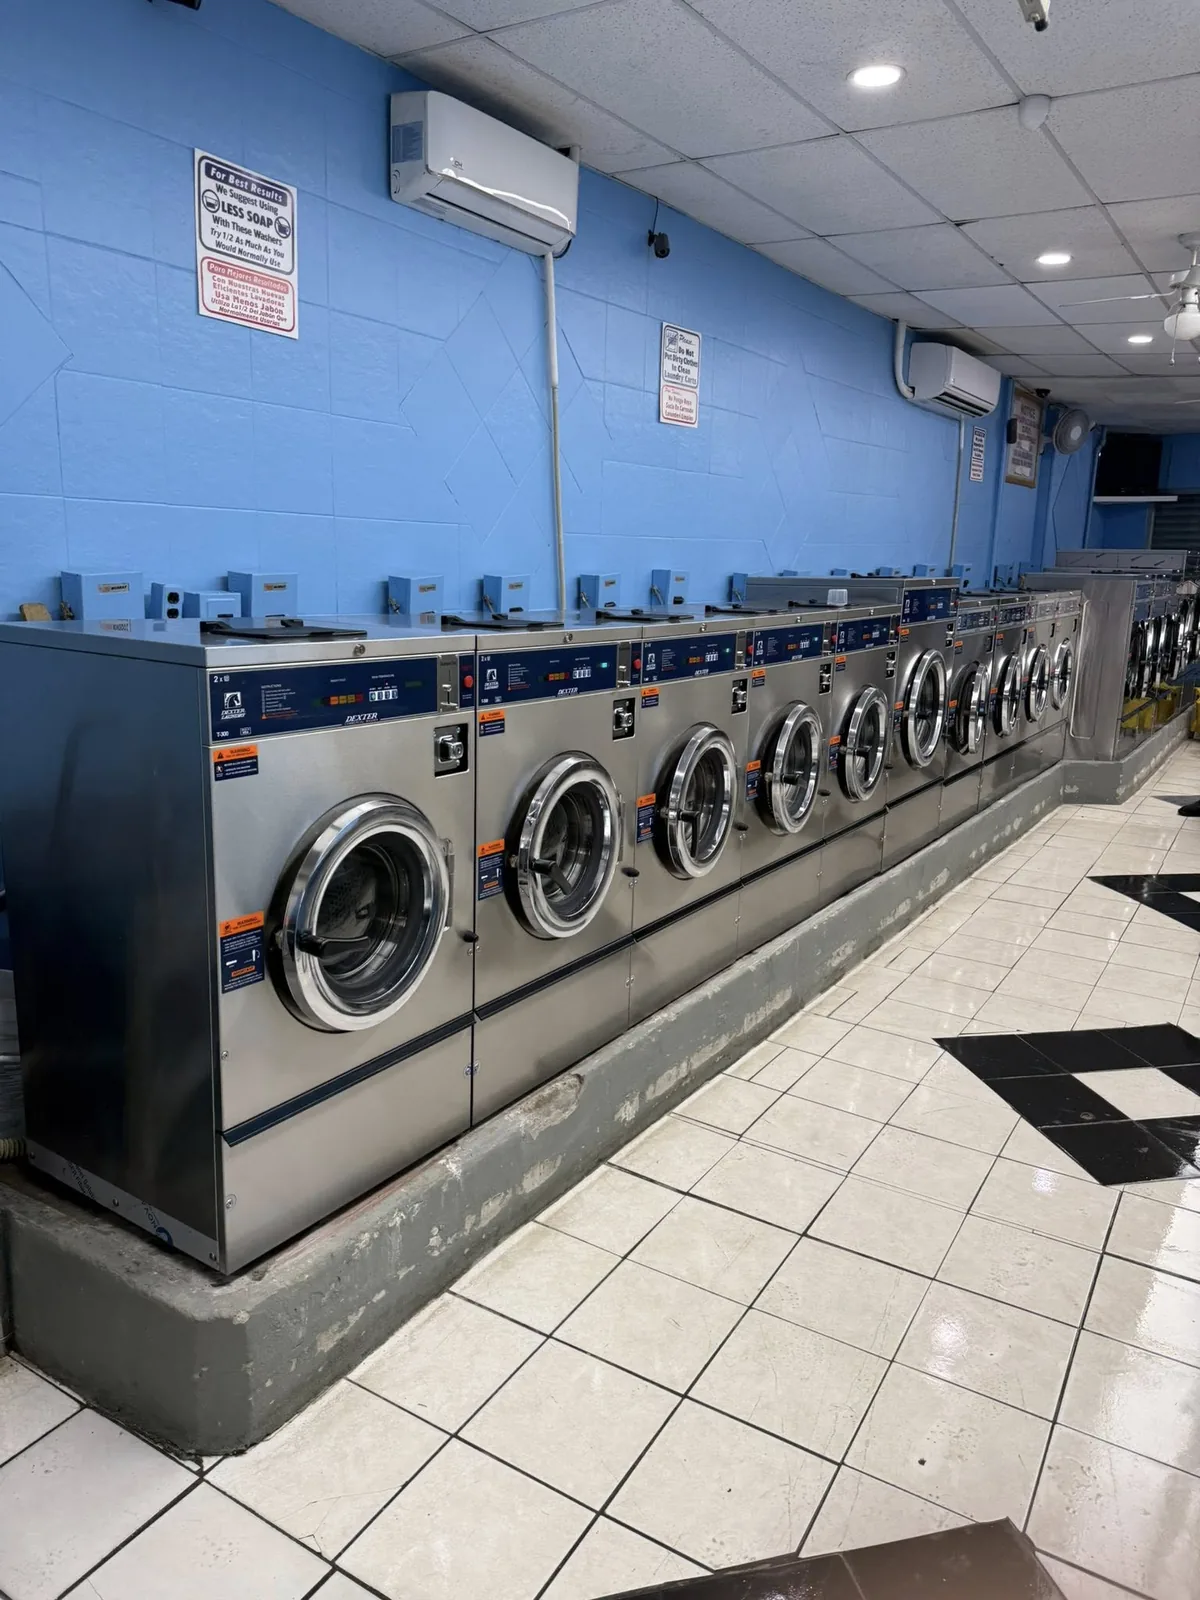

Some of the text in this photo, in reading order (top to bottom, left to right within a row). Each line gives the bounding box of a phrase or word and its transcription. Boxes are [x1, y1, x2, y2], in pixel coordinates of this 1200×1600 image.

[211, 167, 282, 202] For Best Results
[216, 183, 278, 216] We Suggest Using
[222, 200, 273, 228] LESS SOAP
[212, 214, 282, 246] With These Washers
[210, 228, 222, 239] Try
[222, 232, 234, 242] 1/2
[235, 236, 243, 245] As
[245, 240, 262, 251] Much
[273, 248, 284, 258] You
[216, 240, 280, 268] Would Normally Use
[210, 264, 226, 273] Para
[227, 268, 252, 282] Mejores
[212, 275, 226, 284] Con
[228, 280, 259, 293] Nuestras
[213, 282, 284, 307] Eficientes Lavadoras
[215, 290, 230, 300] Usa
[233, 295, 258, 308] Menos
[686, 348, 695, 357] Not
[558, 687, 578, 695] DEXTER
[345, 712, 378, 722] DEXTER
